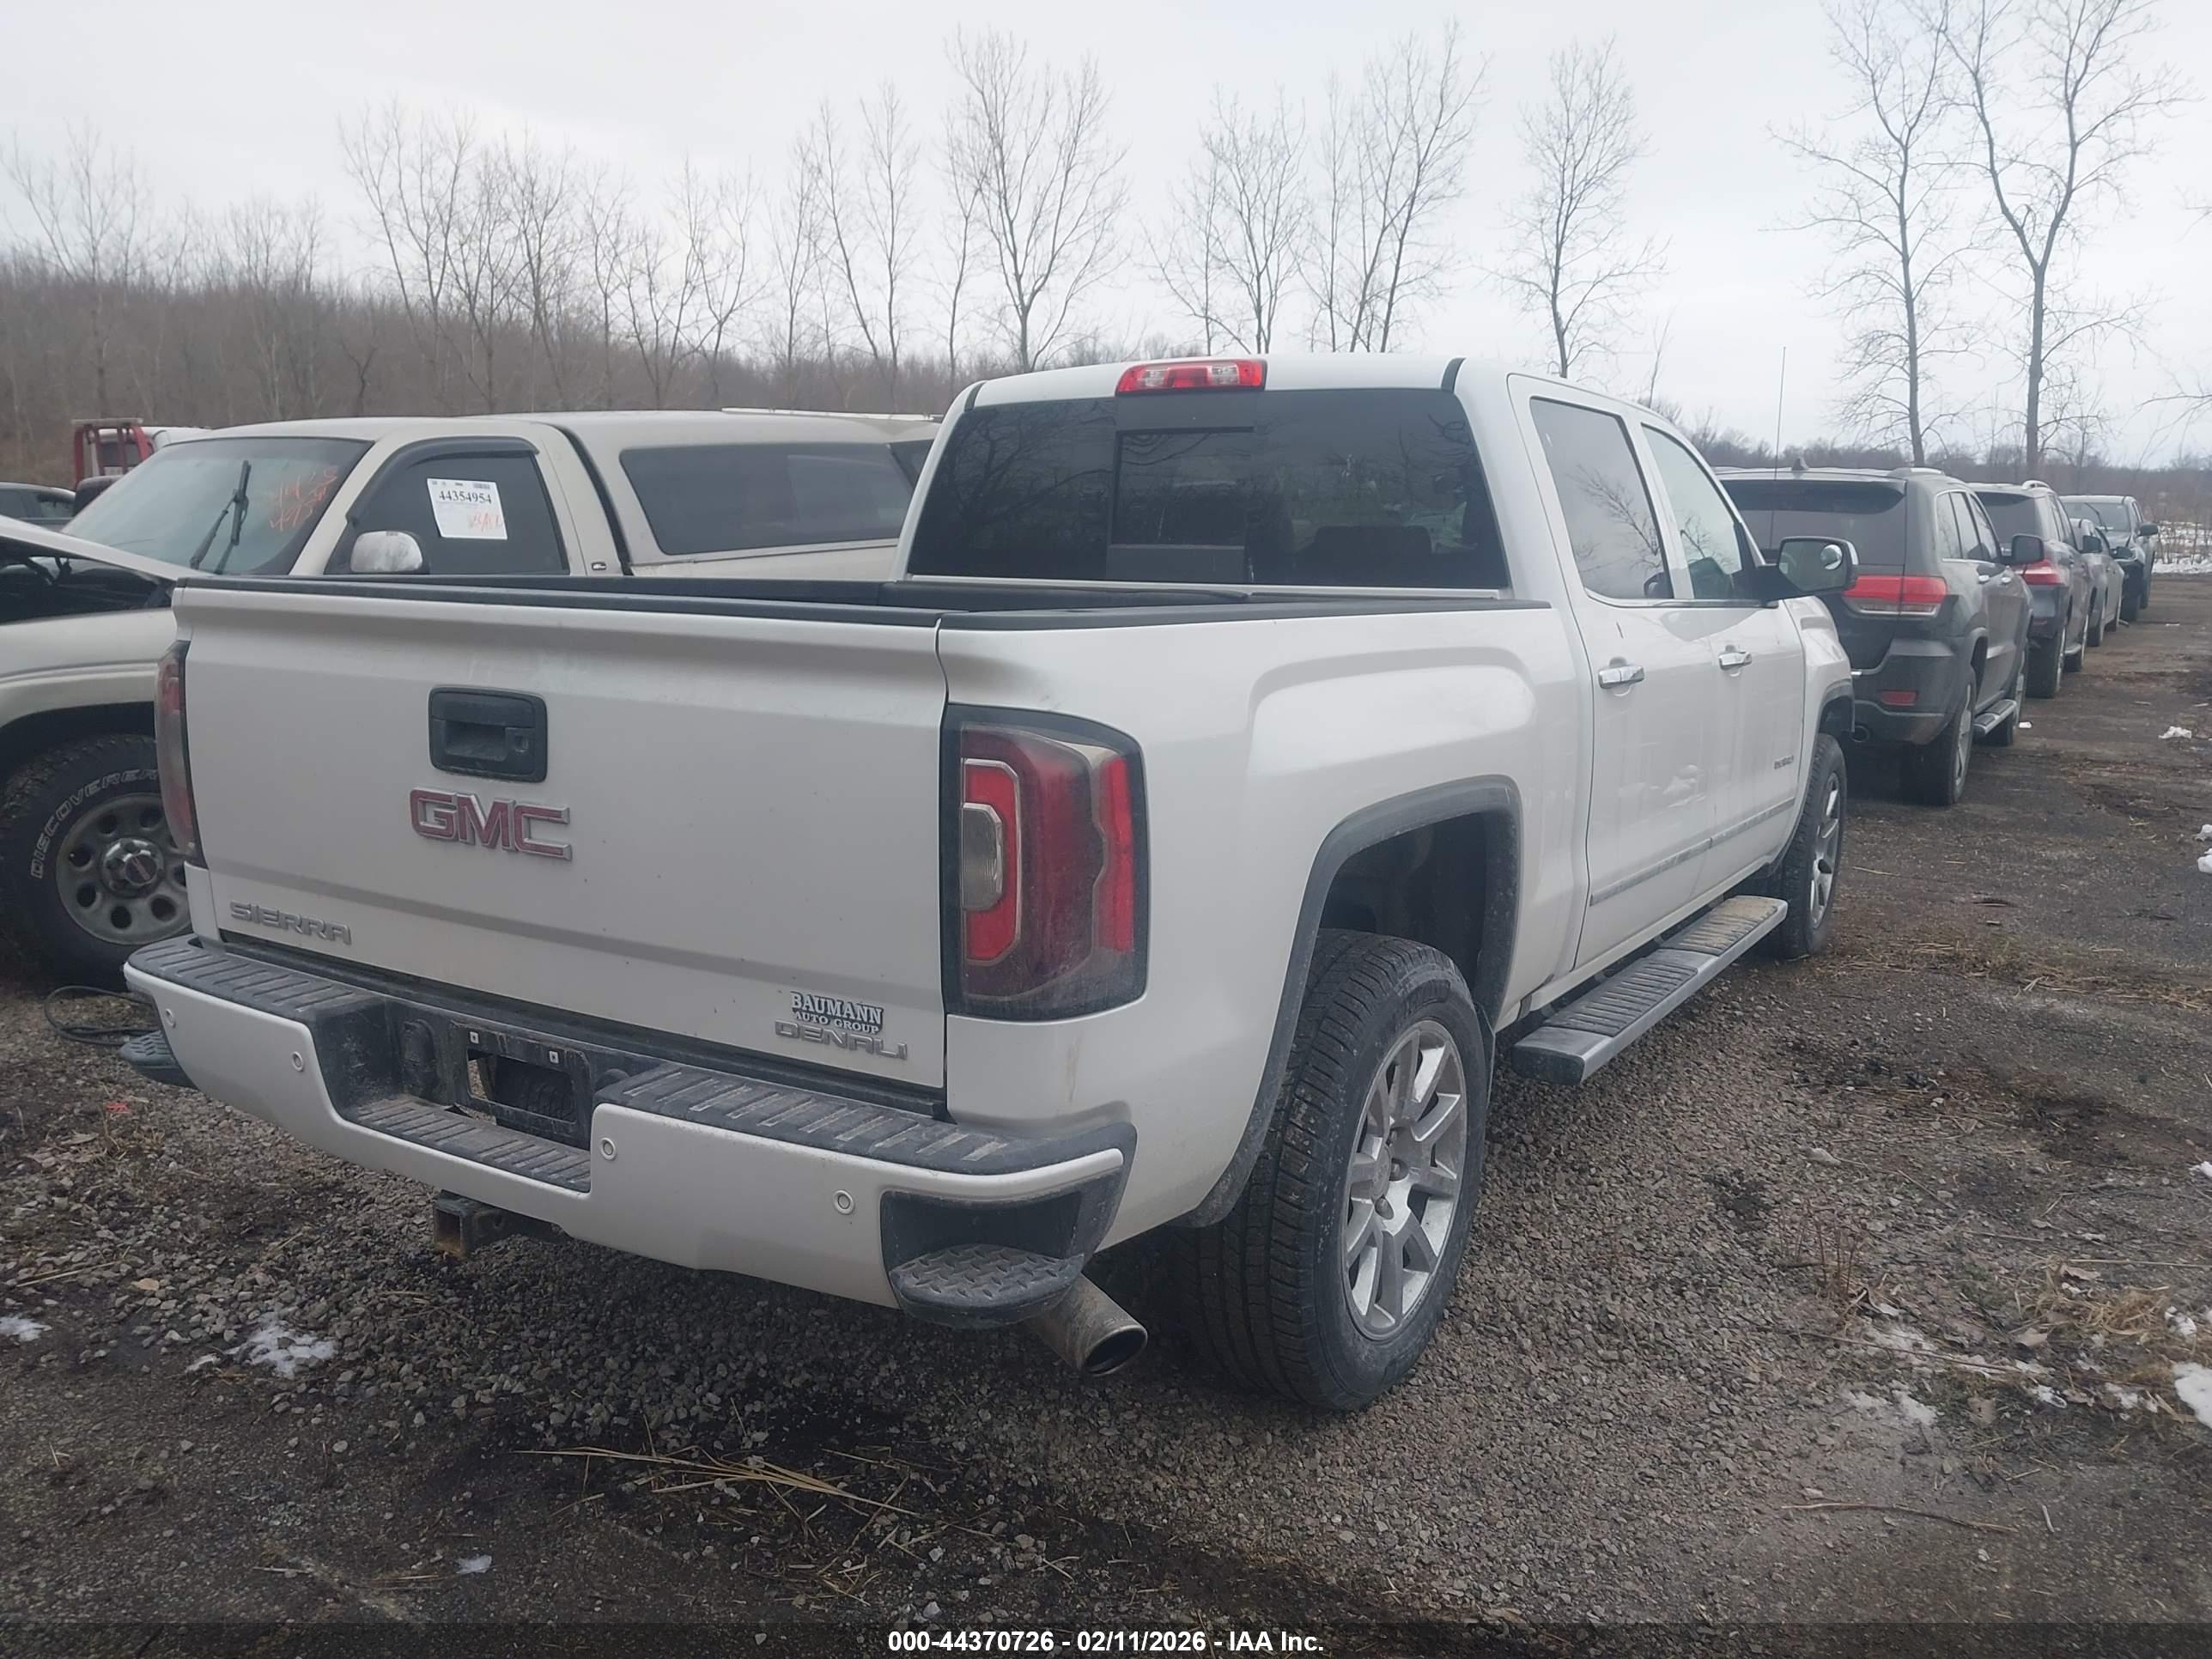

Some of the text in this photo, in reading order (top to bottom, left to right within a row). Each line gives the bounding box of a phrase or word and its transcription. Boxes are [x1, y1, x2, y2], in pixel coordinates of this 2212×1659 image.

[439, 490, 492, 505] 44354954
[409, 787, 573, 860] GMC
[229, 900, 352, 945] SIERRA
[790, 991, 884, 1025] BAUMANN
[795, 1010, 880, 1036] AUTO GROUP
[775, 1019, 908, 1060] DENALI
